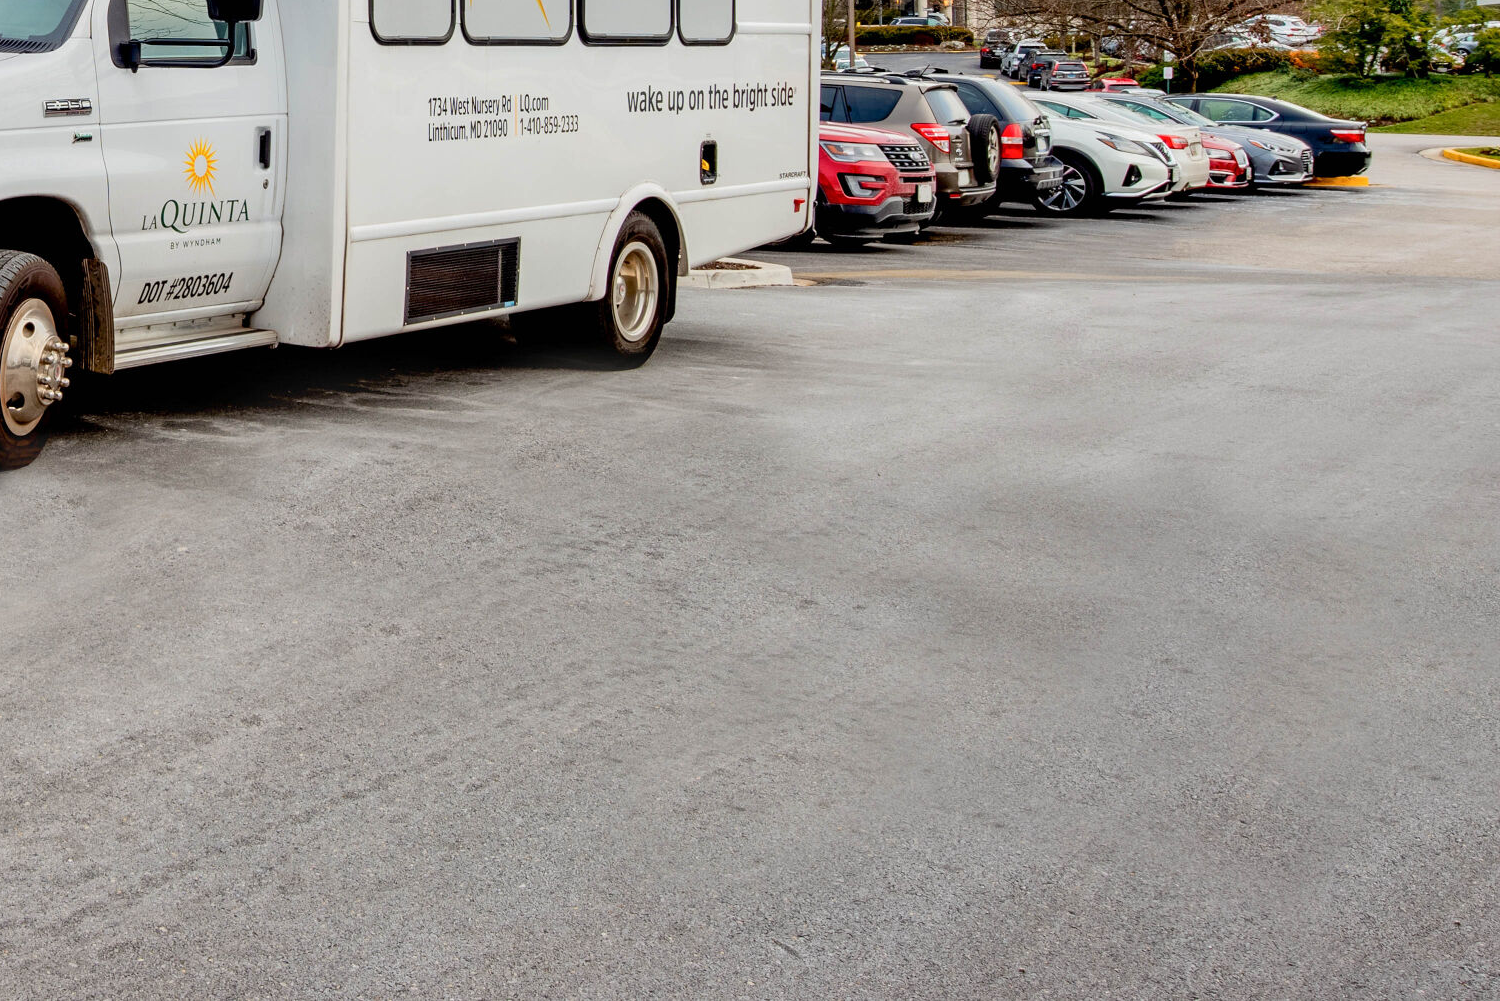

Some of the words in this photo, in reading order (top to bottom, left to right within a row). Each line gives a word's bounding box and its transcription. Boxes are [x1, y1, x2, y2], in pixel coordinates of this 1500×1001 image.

[428, 97, 448, 117] 1734
[449, 96, 470, 116] West
[471, 95, 500, 116] Nursery
[501, 94, 512, 113] Rd
[519, 94, 549, 113] LQ.com
[627, 85, 663, 113] wake
[668, 89, 685, 115] up
[688, 88, 704, 111] on
[708, 83, 729, 110] the
[732, 82, 768, 112] bright
[428, 121, 468, 142] Linthicum,
[470, 120, 482, 139] MD
[483, 118, 508, 138] 21090
[519, 114, 579, 136] 1-410-859-2333
[779, 170, 806, 180] STARCRAFT
[142, 215, 158, 231] LA
[160, 199, 250, 234] QUINTA
[170, 241, 180, 250] BY
[183, 237, 221, 249] WYNDHAM
[137, 280, 168, 305] DOT
[164, 272, 234, 302] #2803604
